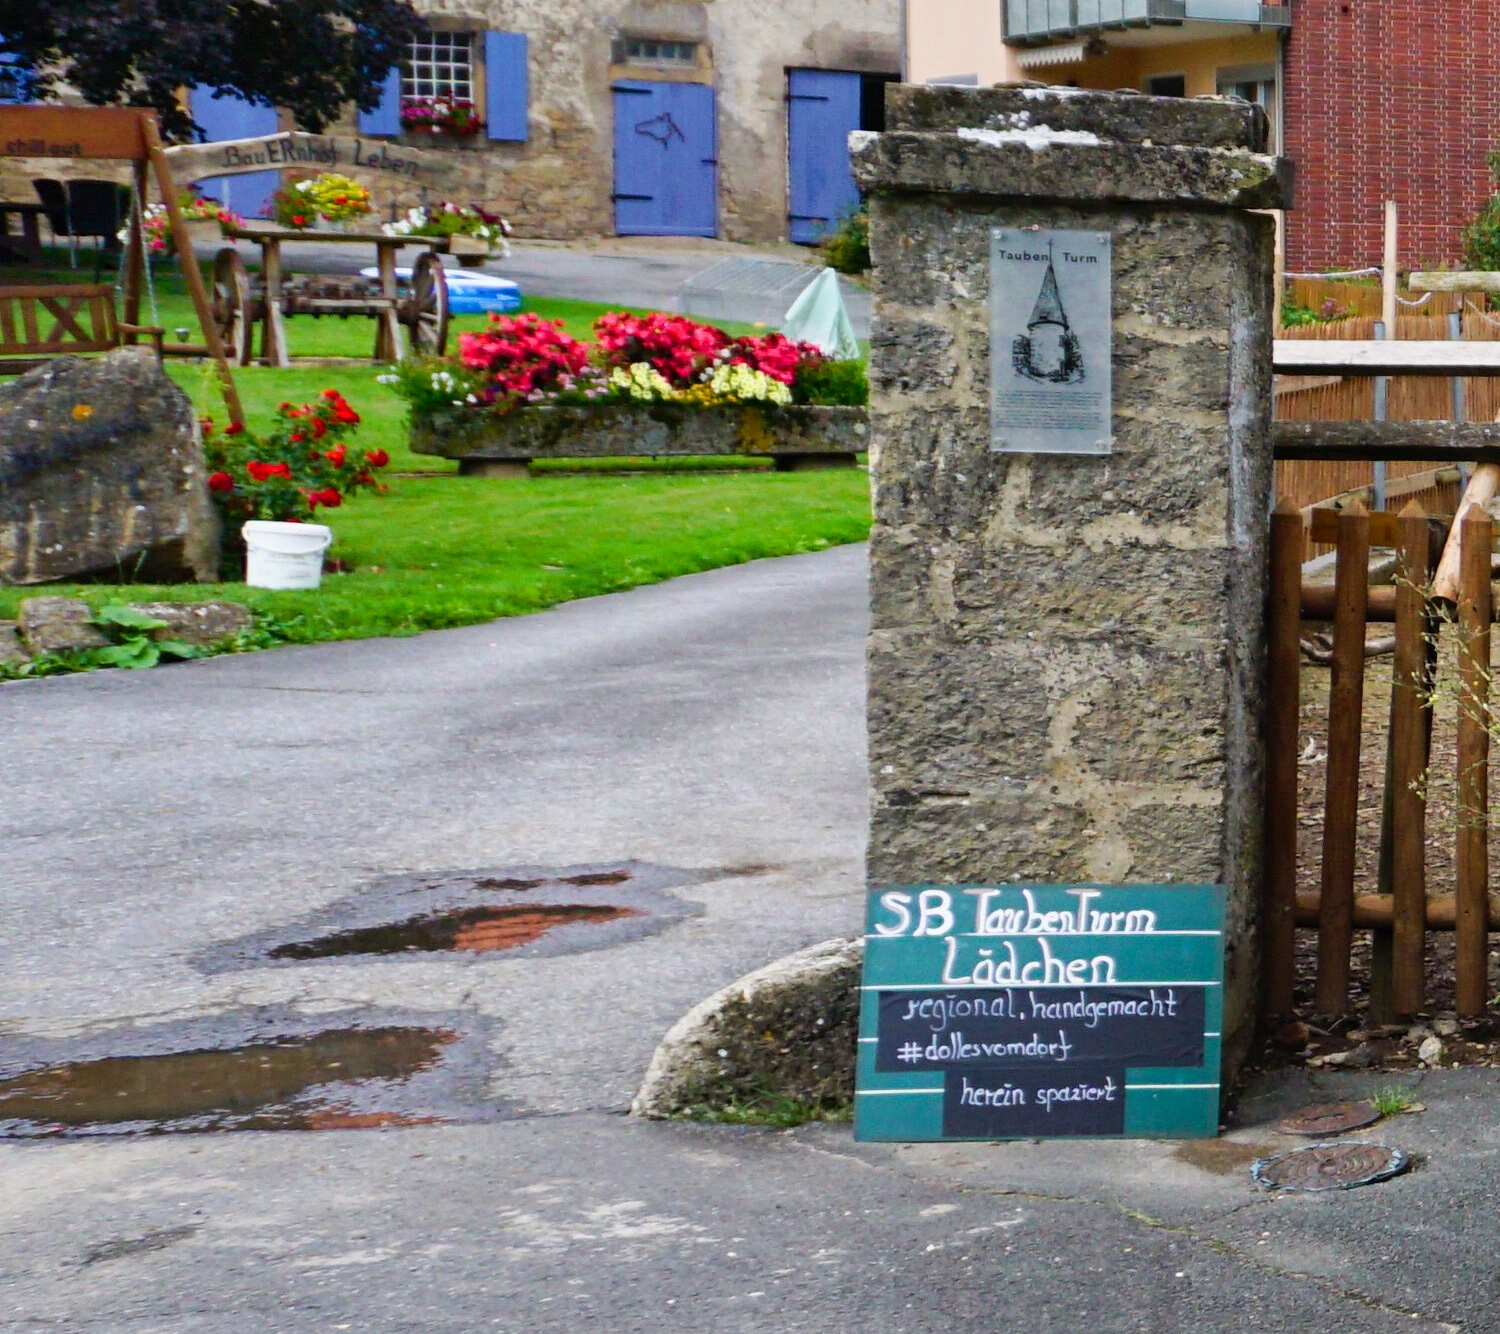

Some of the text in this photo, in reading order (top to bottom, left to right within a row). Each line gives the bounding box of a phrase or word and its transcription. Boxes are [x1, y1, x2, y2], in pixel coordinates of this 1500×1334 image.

[353, 138, 421, 176] Leben
[998, 249, 1098, 263] Tauben Turm
[874, 888, 954, 937] SB
[941, 936, 1118, 986] Lädchen
[1029, 988, 1178, 1029] handgemacht
[896, 1029, 1073, 1063] #dollesvomdorf
[959, 1075, 1117, 1113] herein spaziert
